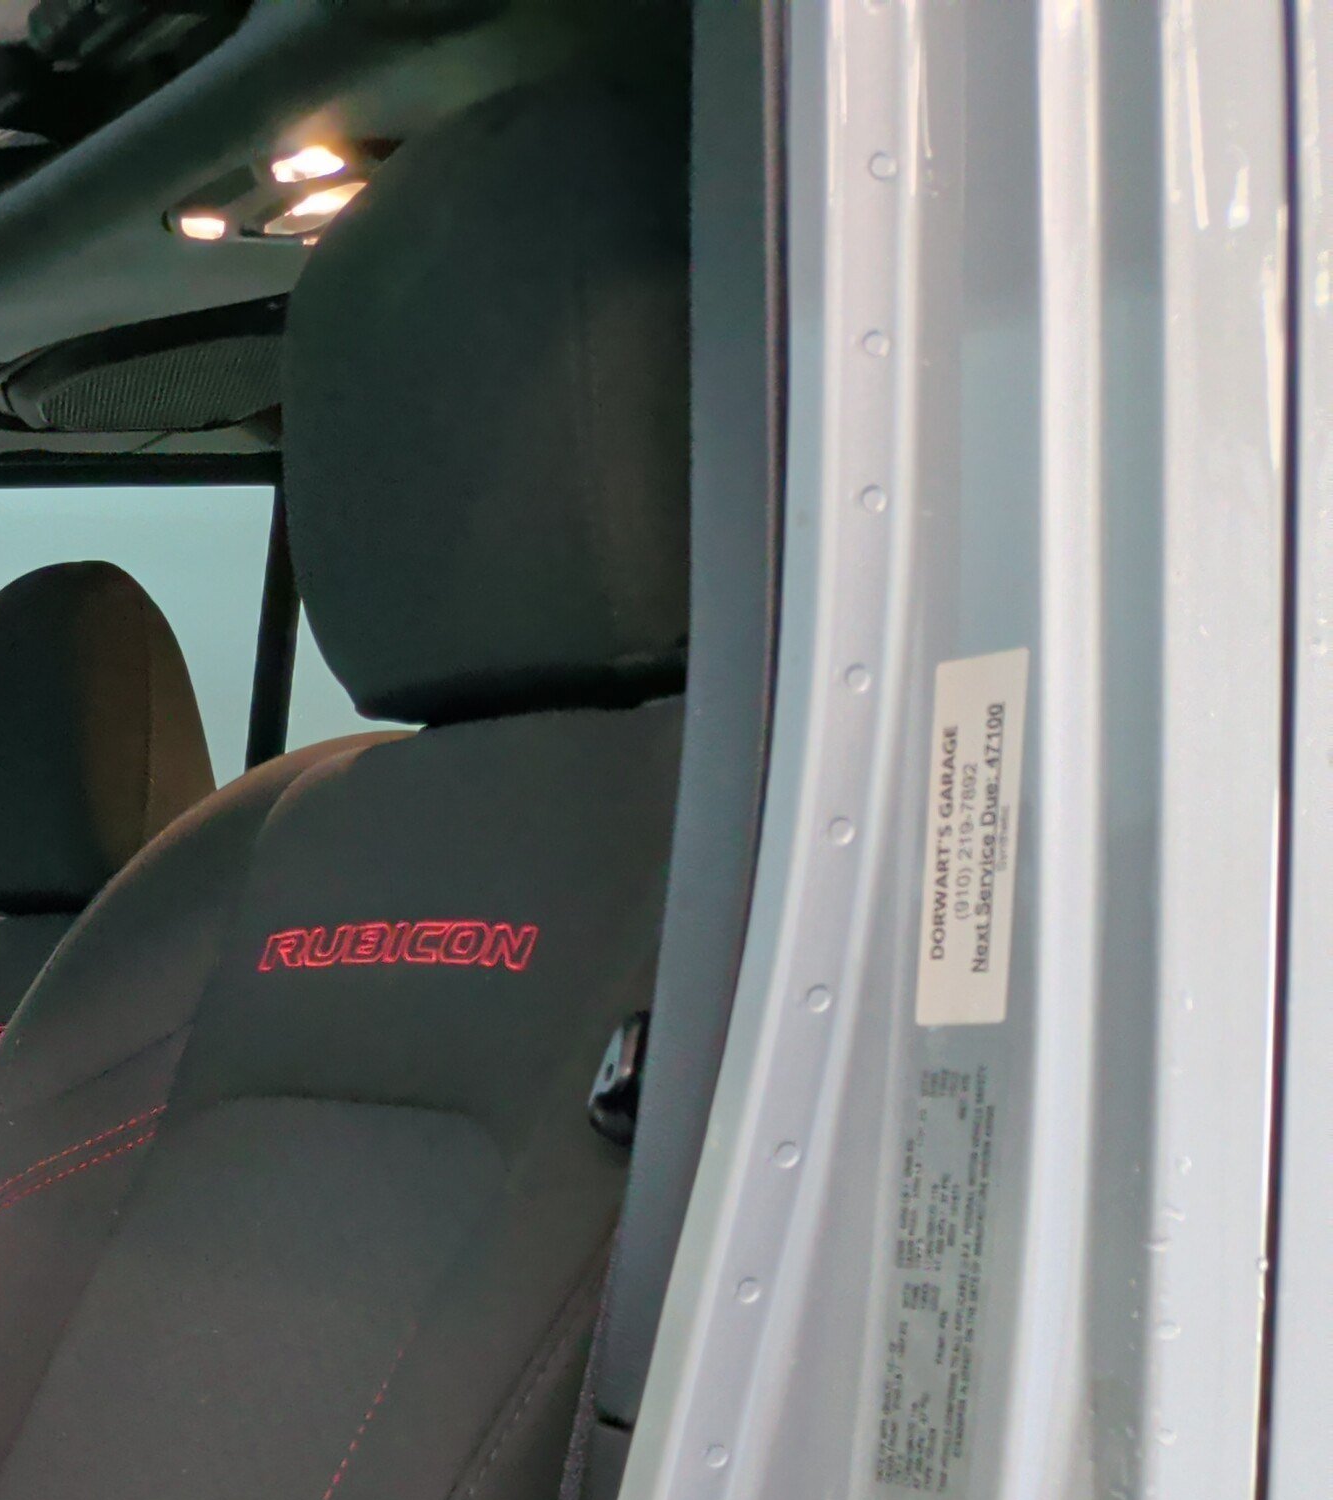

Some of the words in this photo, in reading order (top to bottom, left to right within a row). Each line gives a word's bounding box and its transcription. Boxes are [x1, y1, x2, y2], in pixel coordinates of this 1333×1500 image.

[985, 703, 1004, 768] 47100
[938, 726, 958, 817] GARAGE
[982, 775, 1000, 826] Due:
[930, 825, 952, 960] DORWART'S
[955, 868, 973, 920] (910)
[977, 835, 996, 915] Service
[257, 919, 538, 972] RUBICON
[971, 924, 990, 973] Next
